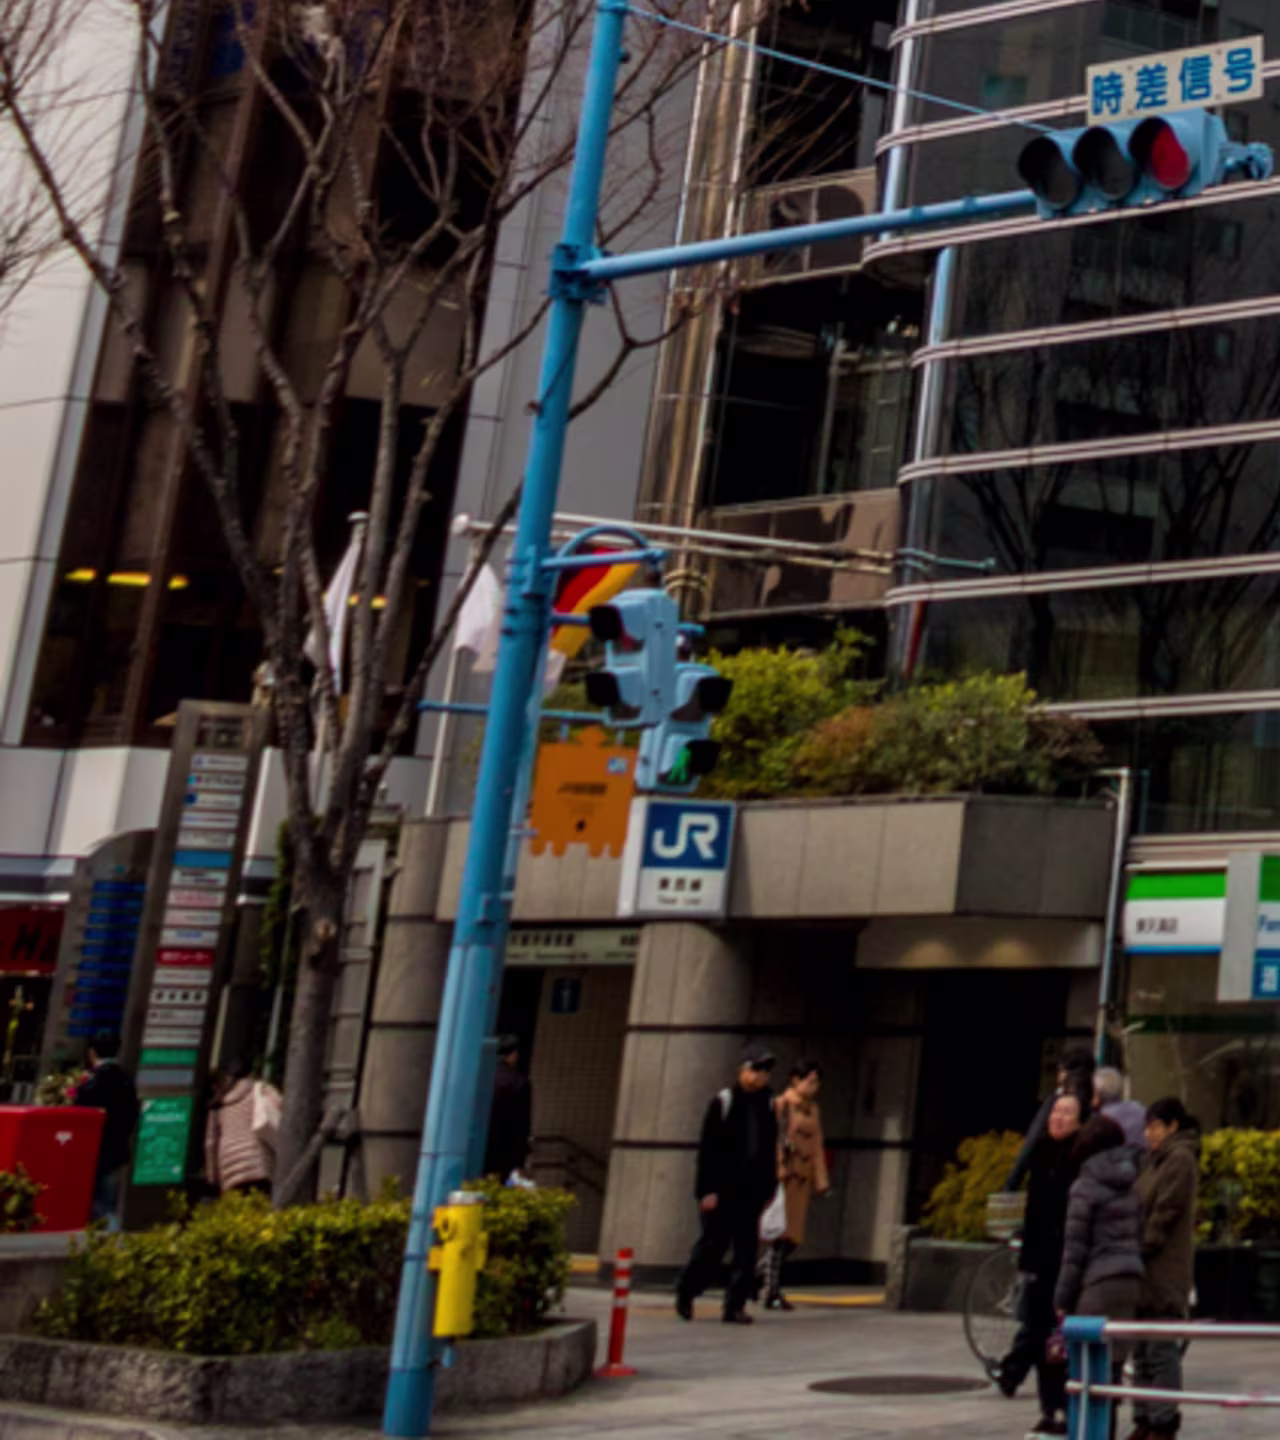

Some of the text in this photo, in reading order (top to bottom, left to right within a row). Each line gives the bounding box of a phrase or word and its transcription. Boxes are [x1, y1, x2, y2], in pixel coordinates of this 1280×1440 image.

[1092, 47, 1256, 115] 時差信号
[652, 812, 720, 862] JR
